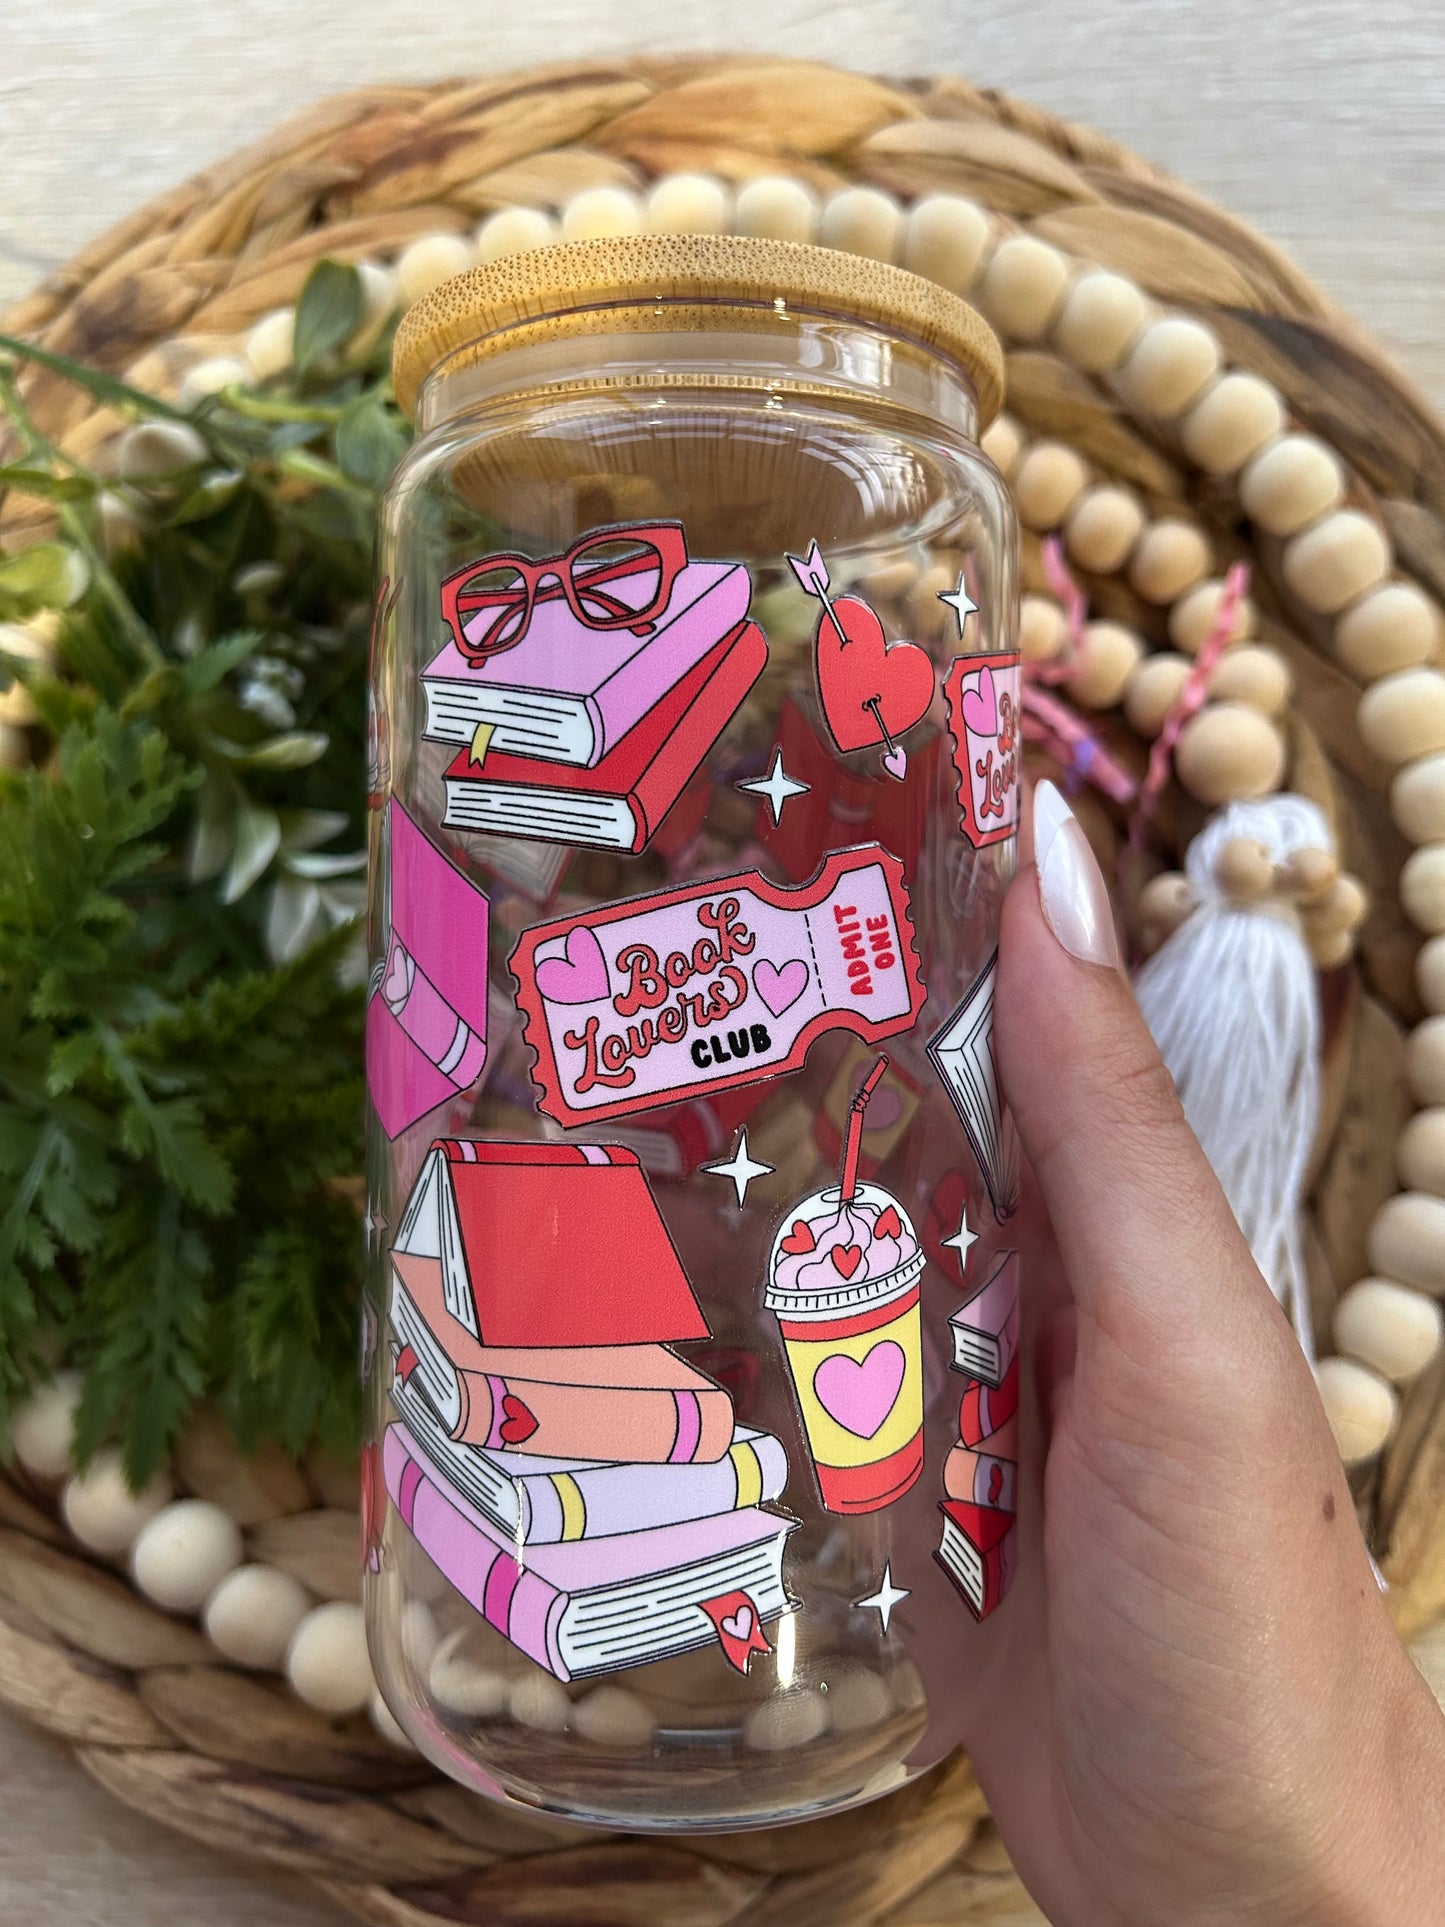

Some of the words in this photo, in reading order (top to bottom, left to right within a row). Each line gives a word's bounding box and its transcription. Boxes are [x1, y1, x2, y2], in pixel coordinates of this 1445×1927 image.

[614, 898, 755, 1017] Book
[833, 904, 873, 996] ADMIT
[867, 914, 896, 971] ONE
[564, 966, 748, 1093] Lovers
[691, 1023, 771, 1069] CLUB
